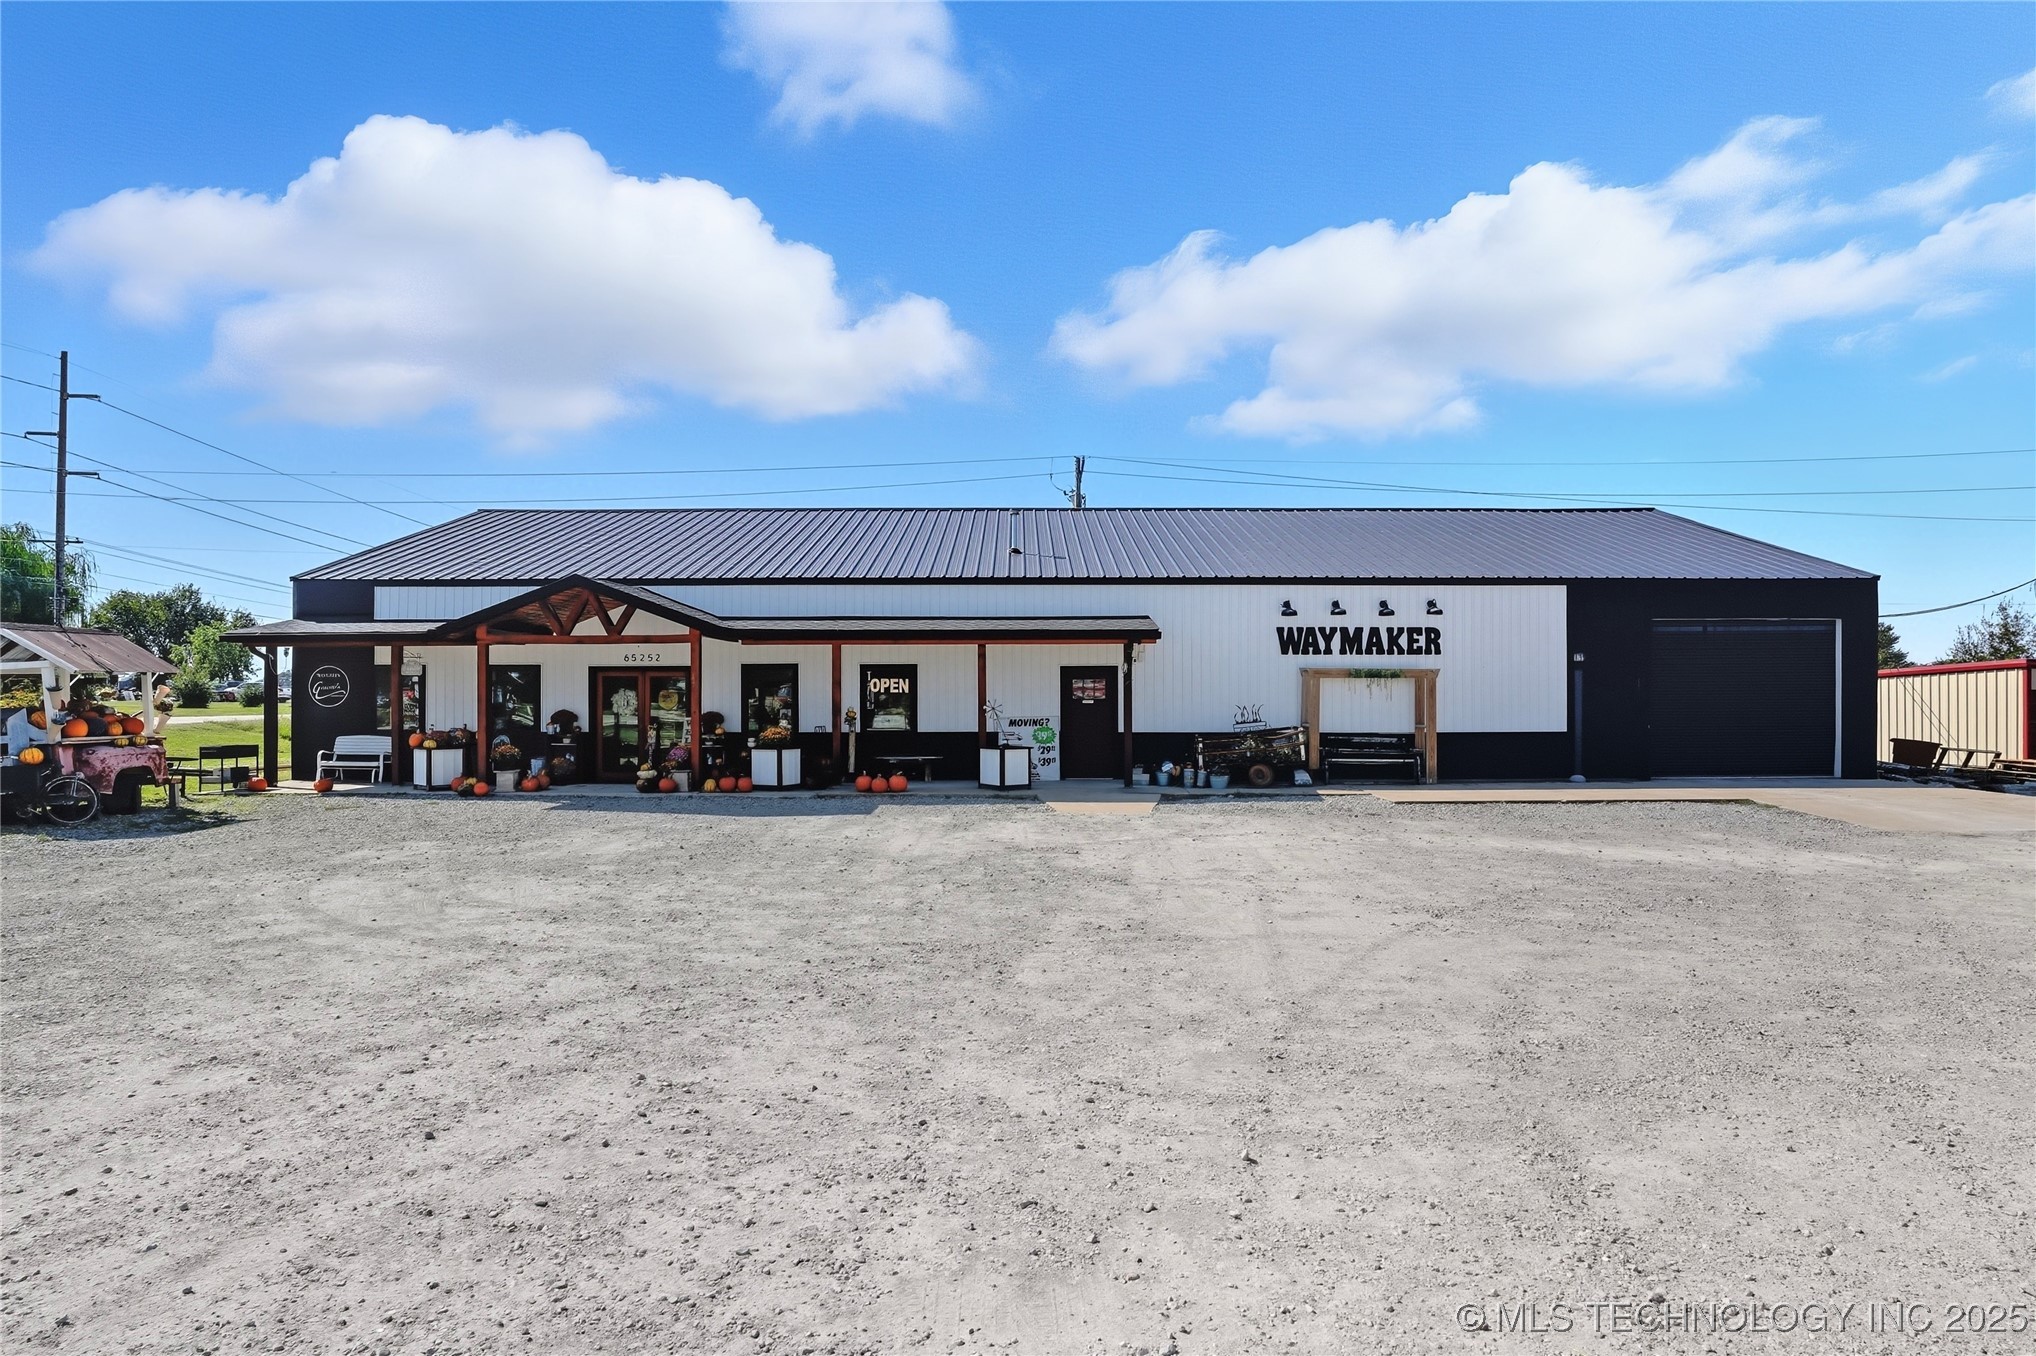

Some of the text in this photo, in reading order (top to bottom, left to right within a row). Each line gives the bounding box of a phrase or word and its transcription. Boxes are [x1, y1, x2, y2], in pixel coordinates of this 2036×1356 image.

[1276, 626, 1442, 656] WAYMAKER
[623, 653, 661, 662] 65252
[870, 678, 909, 693] OPEN
[1008, 718, 1050, 728] MOVING?
